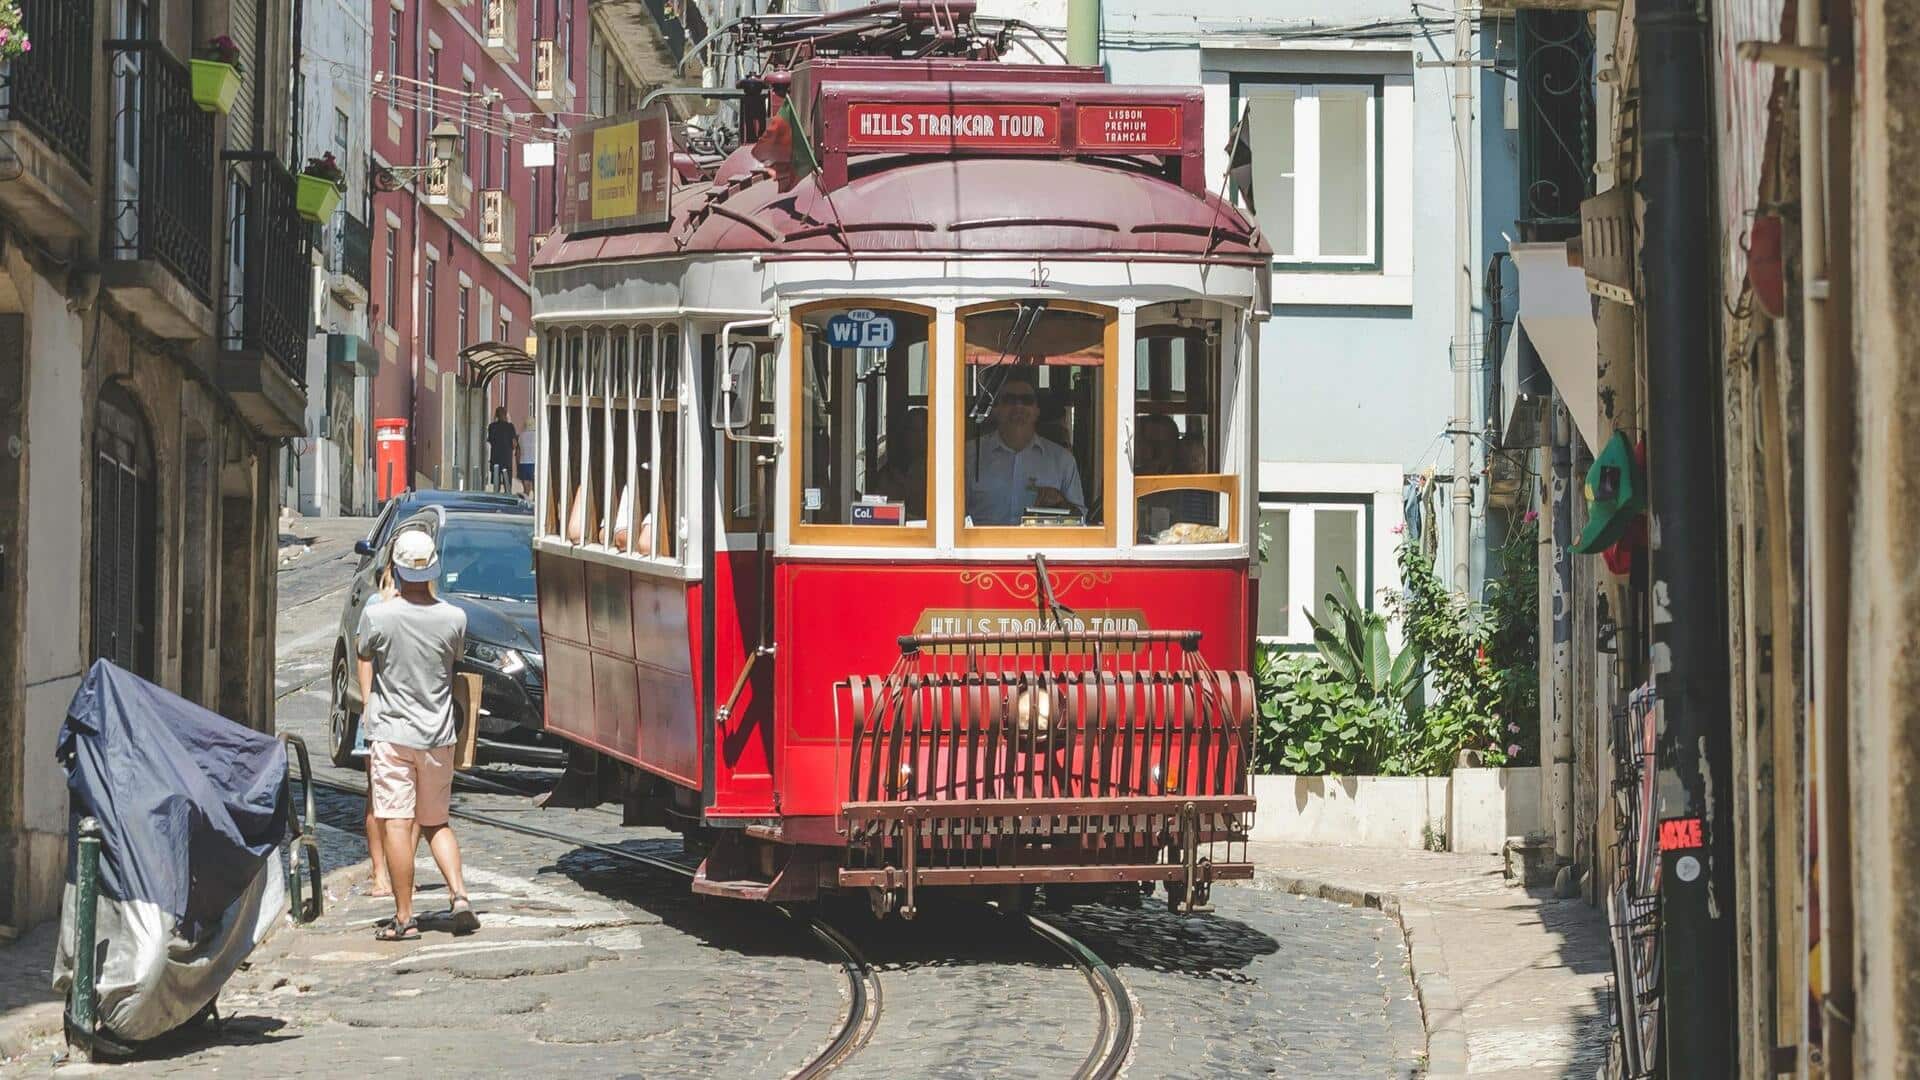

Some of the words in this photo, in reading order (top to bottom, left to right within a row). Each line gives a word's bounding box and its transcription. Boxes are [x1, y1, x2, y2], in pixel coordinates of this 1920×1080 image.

[1108, 110, 1143, 120] LISBON
[860, 113, 914, 136] HILLS
[918, 113, 995, 137] TRAMCAR
[999, 114, 1045, 137] TOUR
[1104, 121, 1147, 131] PREMIUM
[1105, 132, 1147, 142] TRAMCAR
[1030, 267, 1050, 288] 12
[852, 311, 871, 319] FREE
